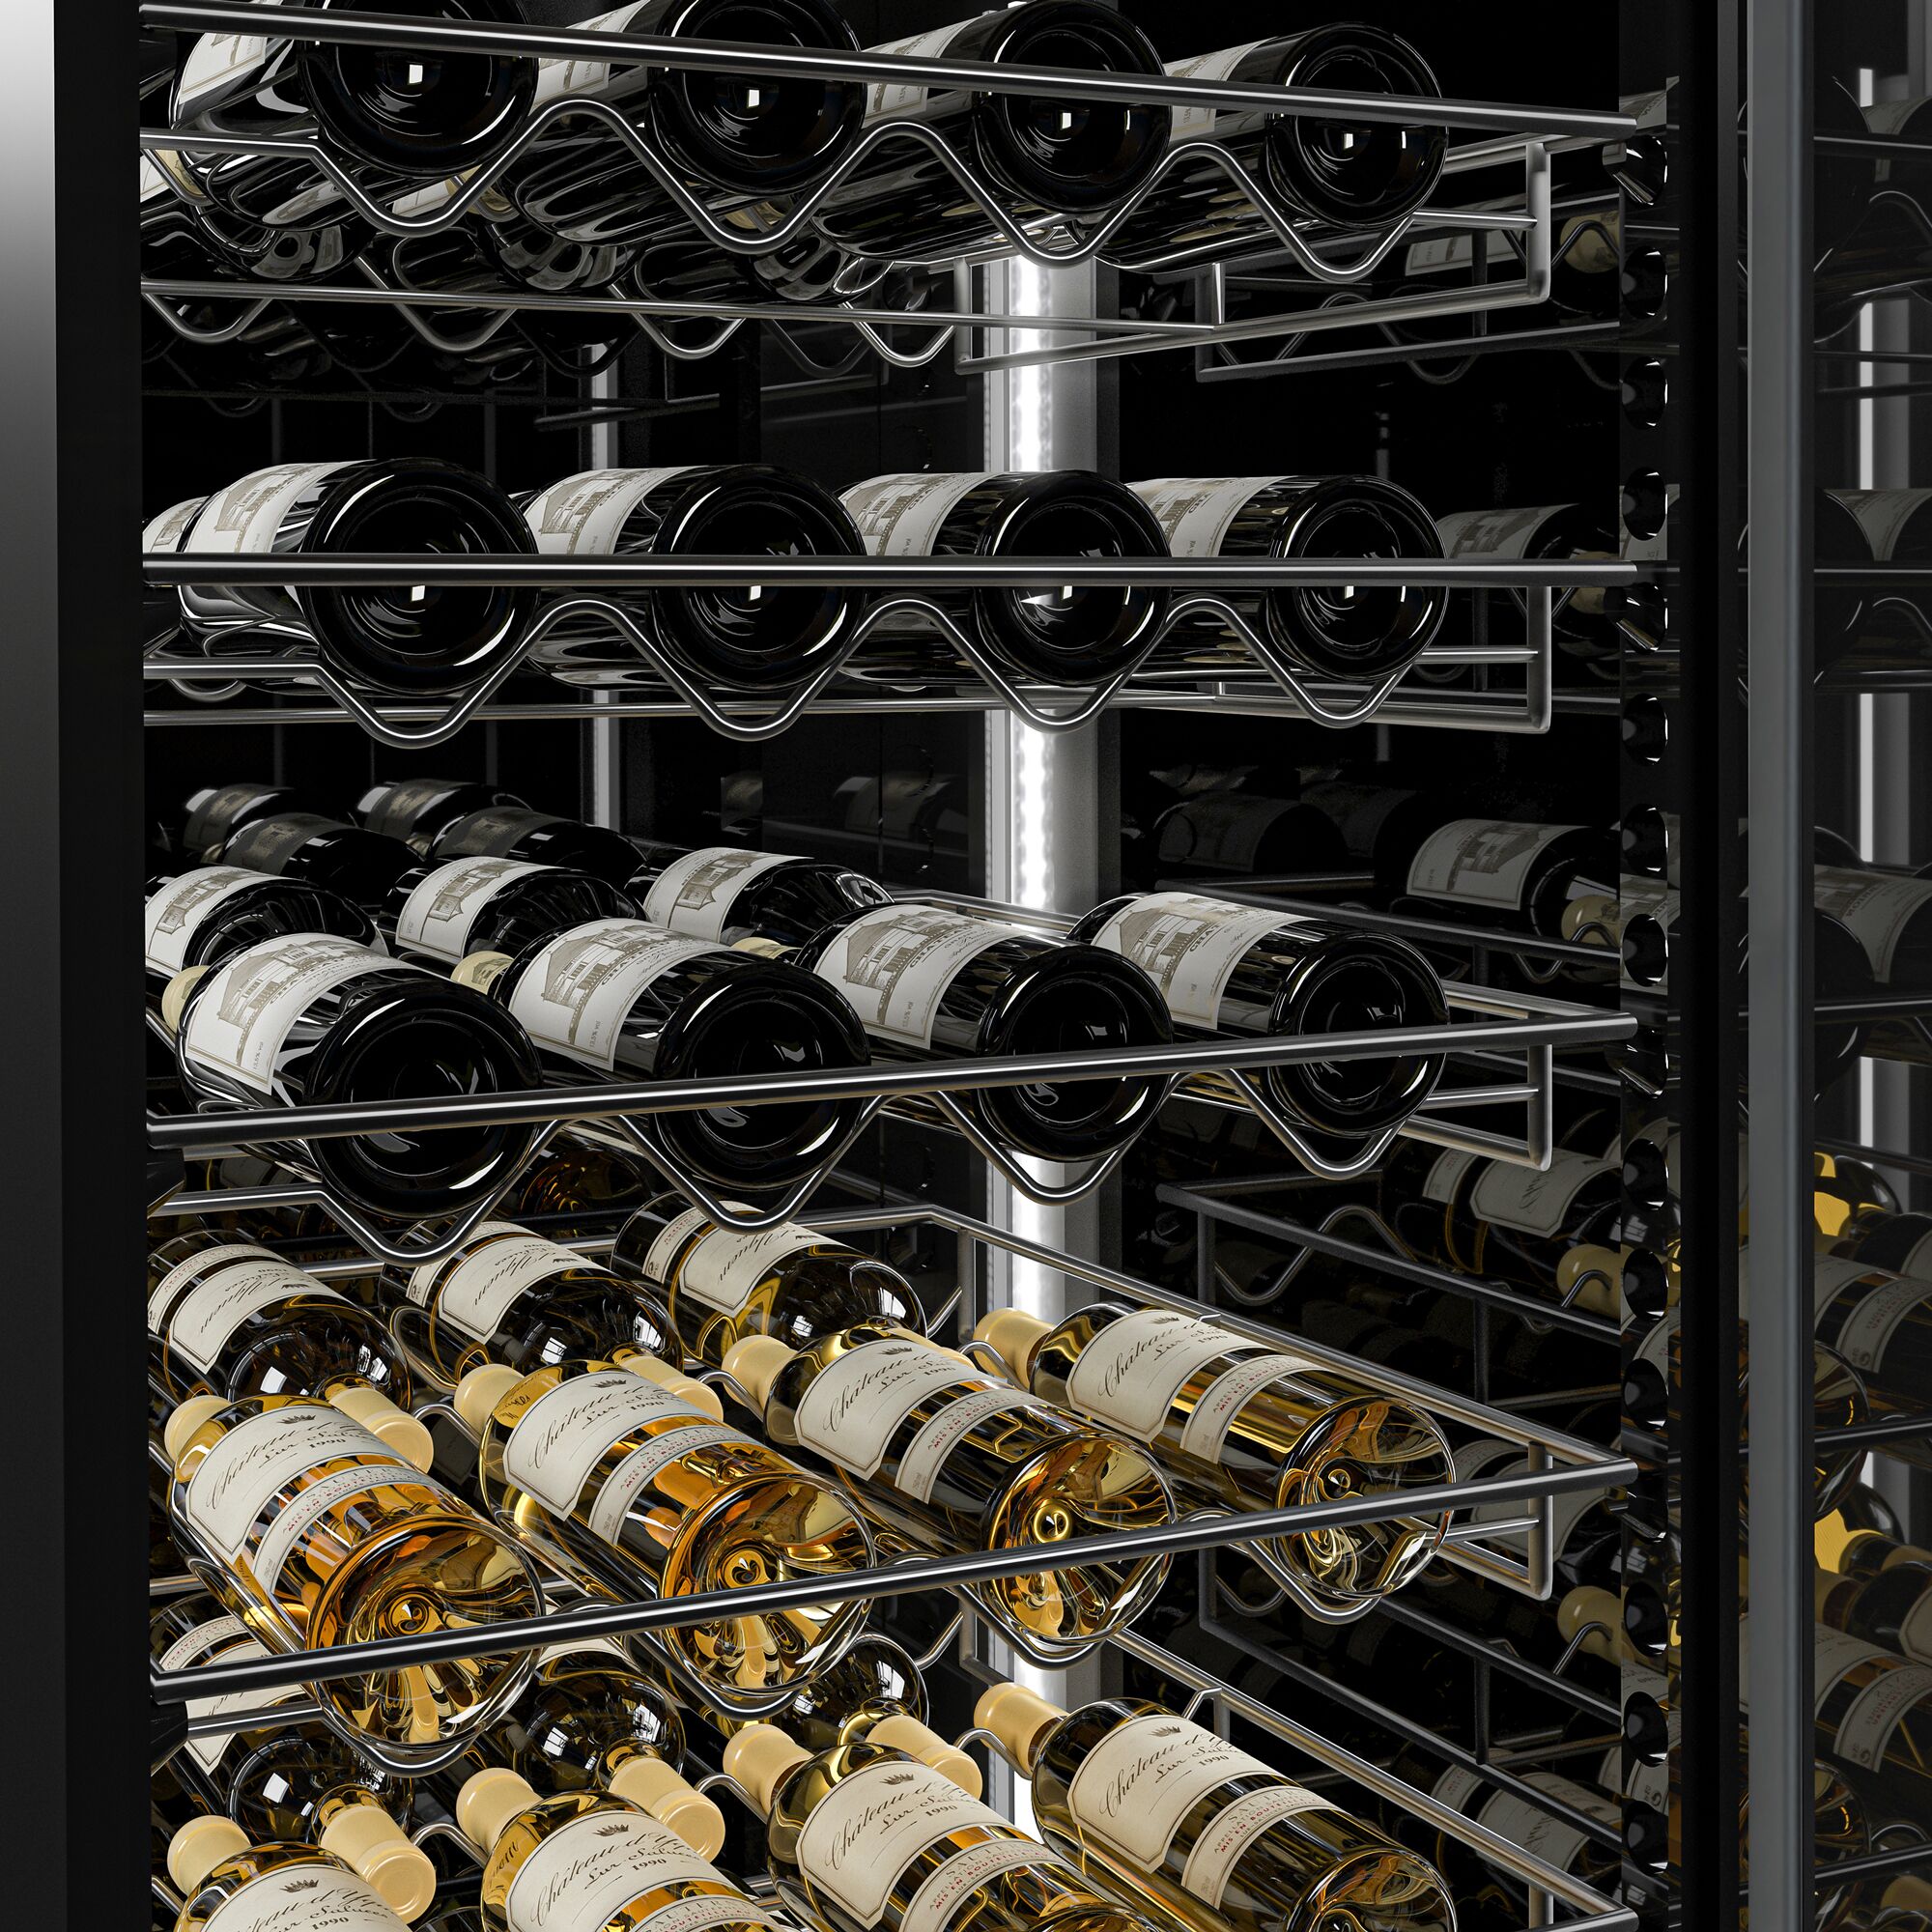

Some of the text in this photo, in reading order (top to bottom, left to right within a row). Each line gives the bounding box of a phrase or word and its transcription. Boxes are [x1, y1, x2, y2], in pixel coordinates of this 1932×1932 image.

[1219, 1397, 1233, 1411] MIS
[934, 1434, 947, 1449] MIS
[626, 1473, 639, 1489] MIS
[288, 1515, 302, 1533] MIS
[1198, 1754, 1230, 1767] 1990
[924, 1803, 958, 1818] 1990
[1221, 1837, 1234, 1853] MIS
[1236, 1823, 1247, 1834] EN
[632, 1859, 668, 1872] 1990
[935, 1893, 949, 1910] MIS
[951, 1878, 963, 1890] EN
[312, 1917, 351, 1931] 1990
